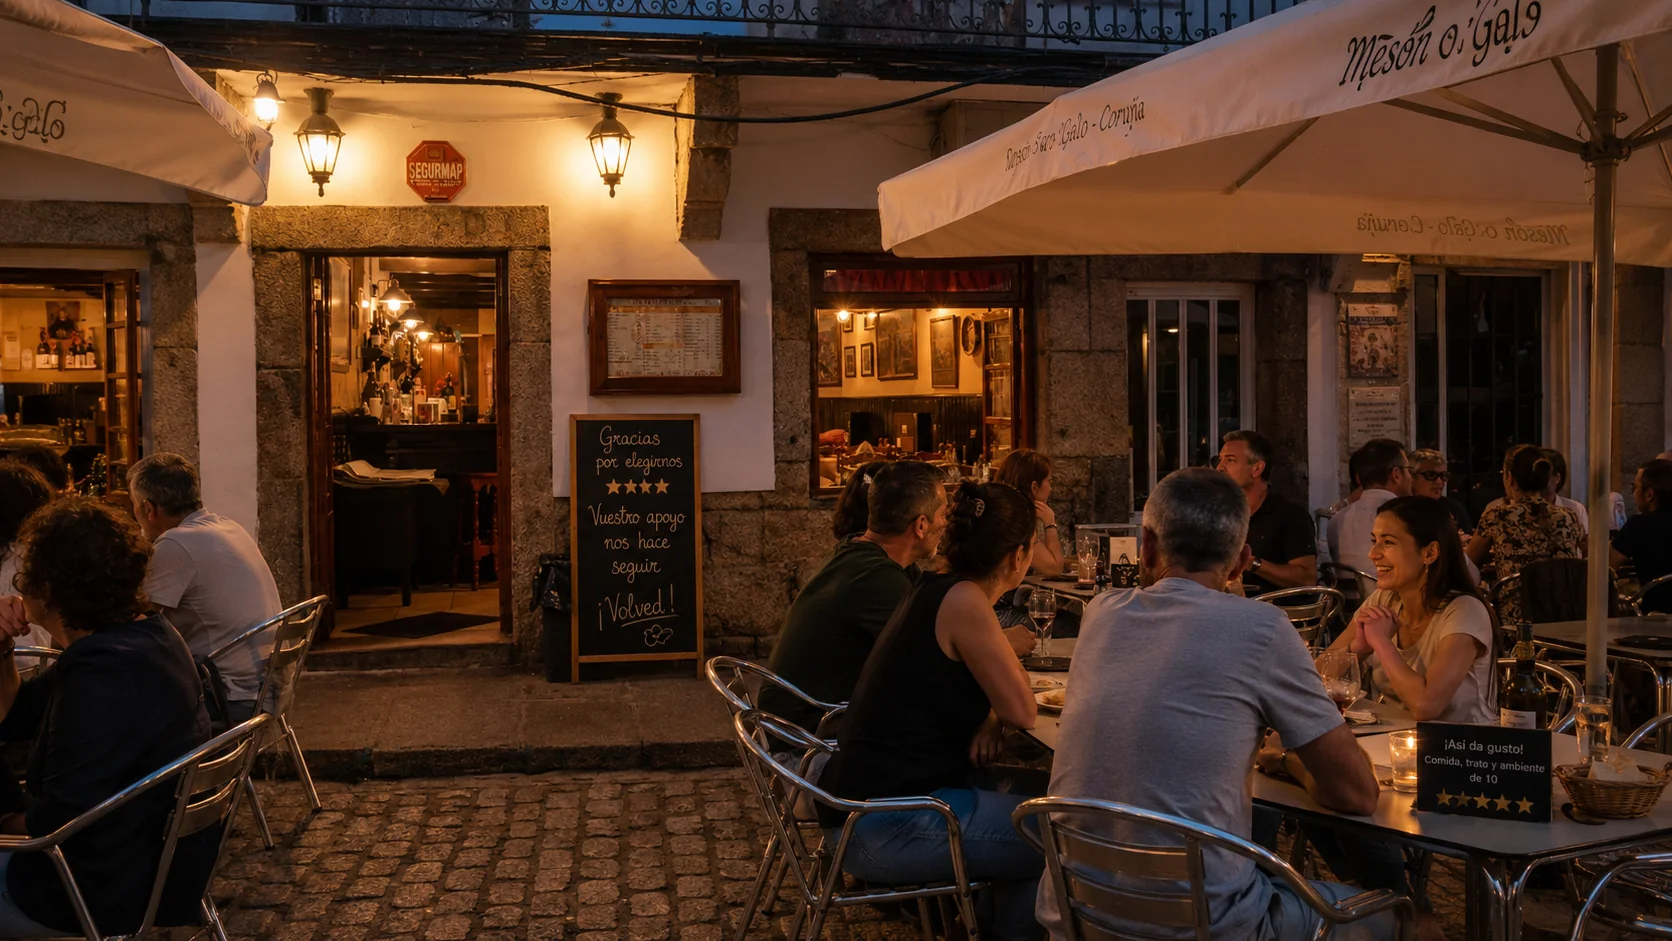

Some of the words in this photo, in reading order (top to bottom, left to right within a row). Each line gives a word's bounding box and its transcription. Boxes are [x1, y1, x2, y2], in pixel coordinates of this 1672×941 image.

[409, 162, 463, 179] SEGURMAP
[600, 425, 661, 454] Gracias
[596, 457, 619, 476] por
[625, 451, 683, 476] elegirnos
[587, 502, 640, 526] Vuestro
[646, 512, 687, 533] apoyo
[604, 537, 630, 550] nos
[638, 530, 671, 550] hace
[611, 558, 662, 584] seguir
[1469, 740, 1484, 752] da
[1487, 743, 1524, 755] gusto!
[1424, 755, 1463, 768] Comida,
[1465, 759, 1489, 769] trato
[1491, 761, 1498, 771] y
[1499, 761, 1545, 773] ambiente
[1469, 773, 1482, 783] de
[1486, 774, 1498, 784] 10
